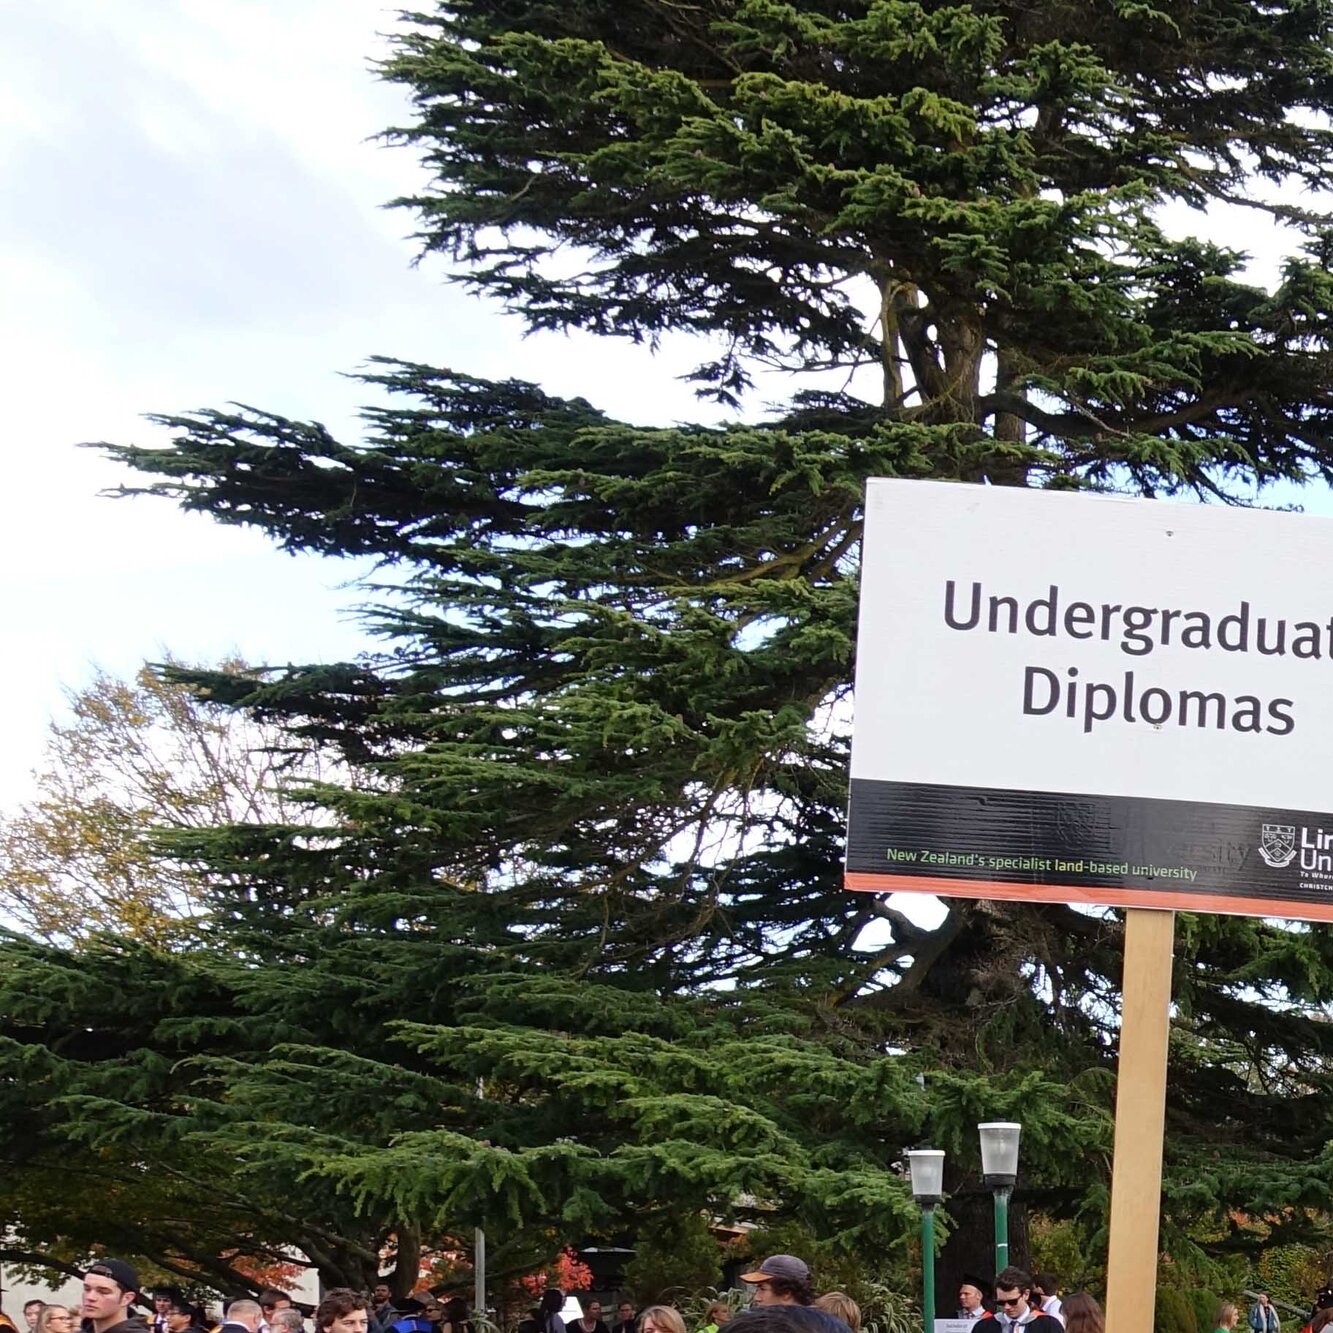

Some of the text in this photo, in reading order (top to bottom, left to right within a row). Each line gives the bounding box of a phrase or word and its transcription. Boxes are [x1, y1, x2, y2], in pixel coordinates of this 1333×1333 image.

[1023, 665, 1295, 736] Diplomas
[887, 848, 1198, 882] New Zealand's specialist land-based university
